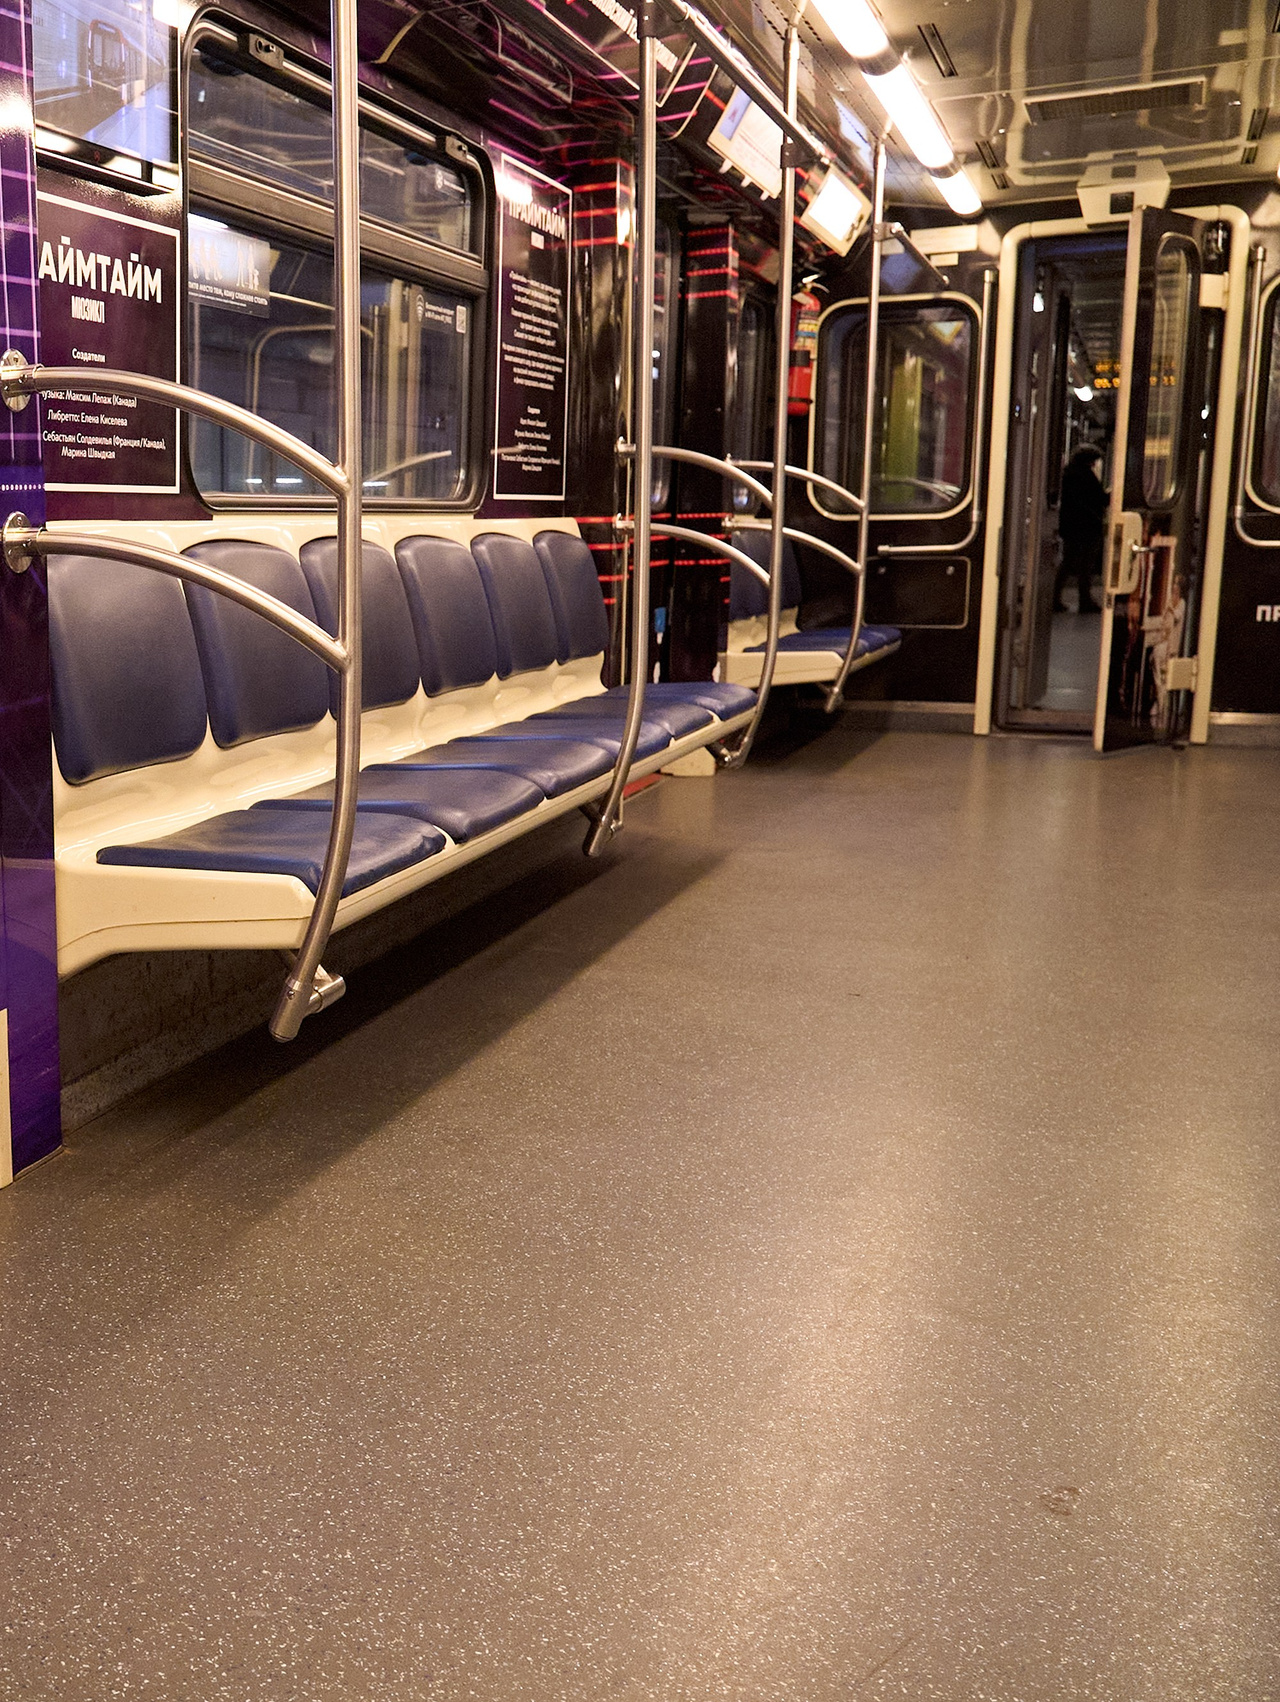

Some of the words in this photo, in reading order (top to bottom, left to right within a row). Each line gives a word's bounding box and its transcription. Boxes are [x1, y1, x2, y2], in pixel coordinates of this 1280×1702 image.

[38, 235, 162, 304] АЙМТАЙМ
[71, 295, 105, 324] МЮЗИКЛ
[72, 347, 106, 362] Создатели
[65, 389, 91, 402] Максим
[91, 392, 112, 405] Лепаж
[112, 394, 137, 408] (Канада)
[47, 408, 80, 423] Либретто:
[80, 411, 100, 424] Елена
[100, 414, 128, 426] Киселева
[42, 430, 76, 443] Себастьян
[61, 446, 87, 459] Марина
[87, 447, 116, 460] Швыдкая
